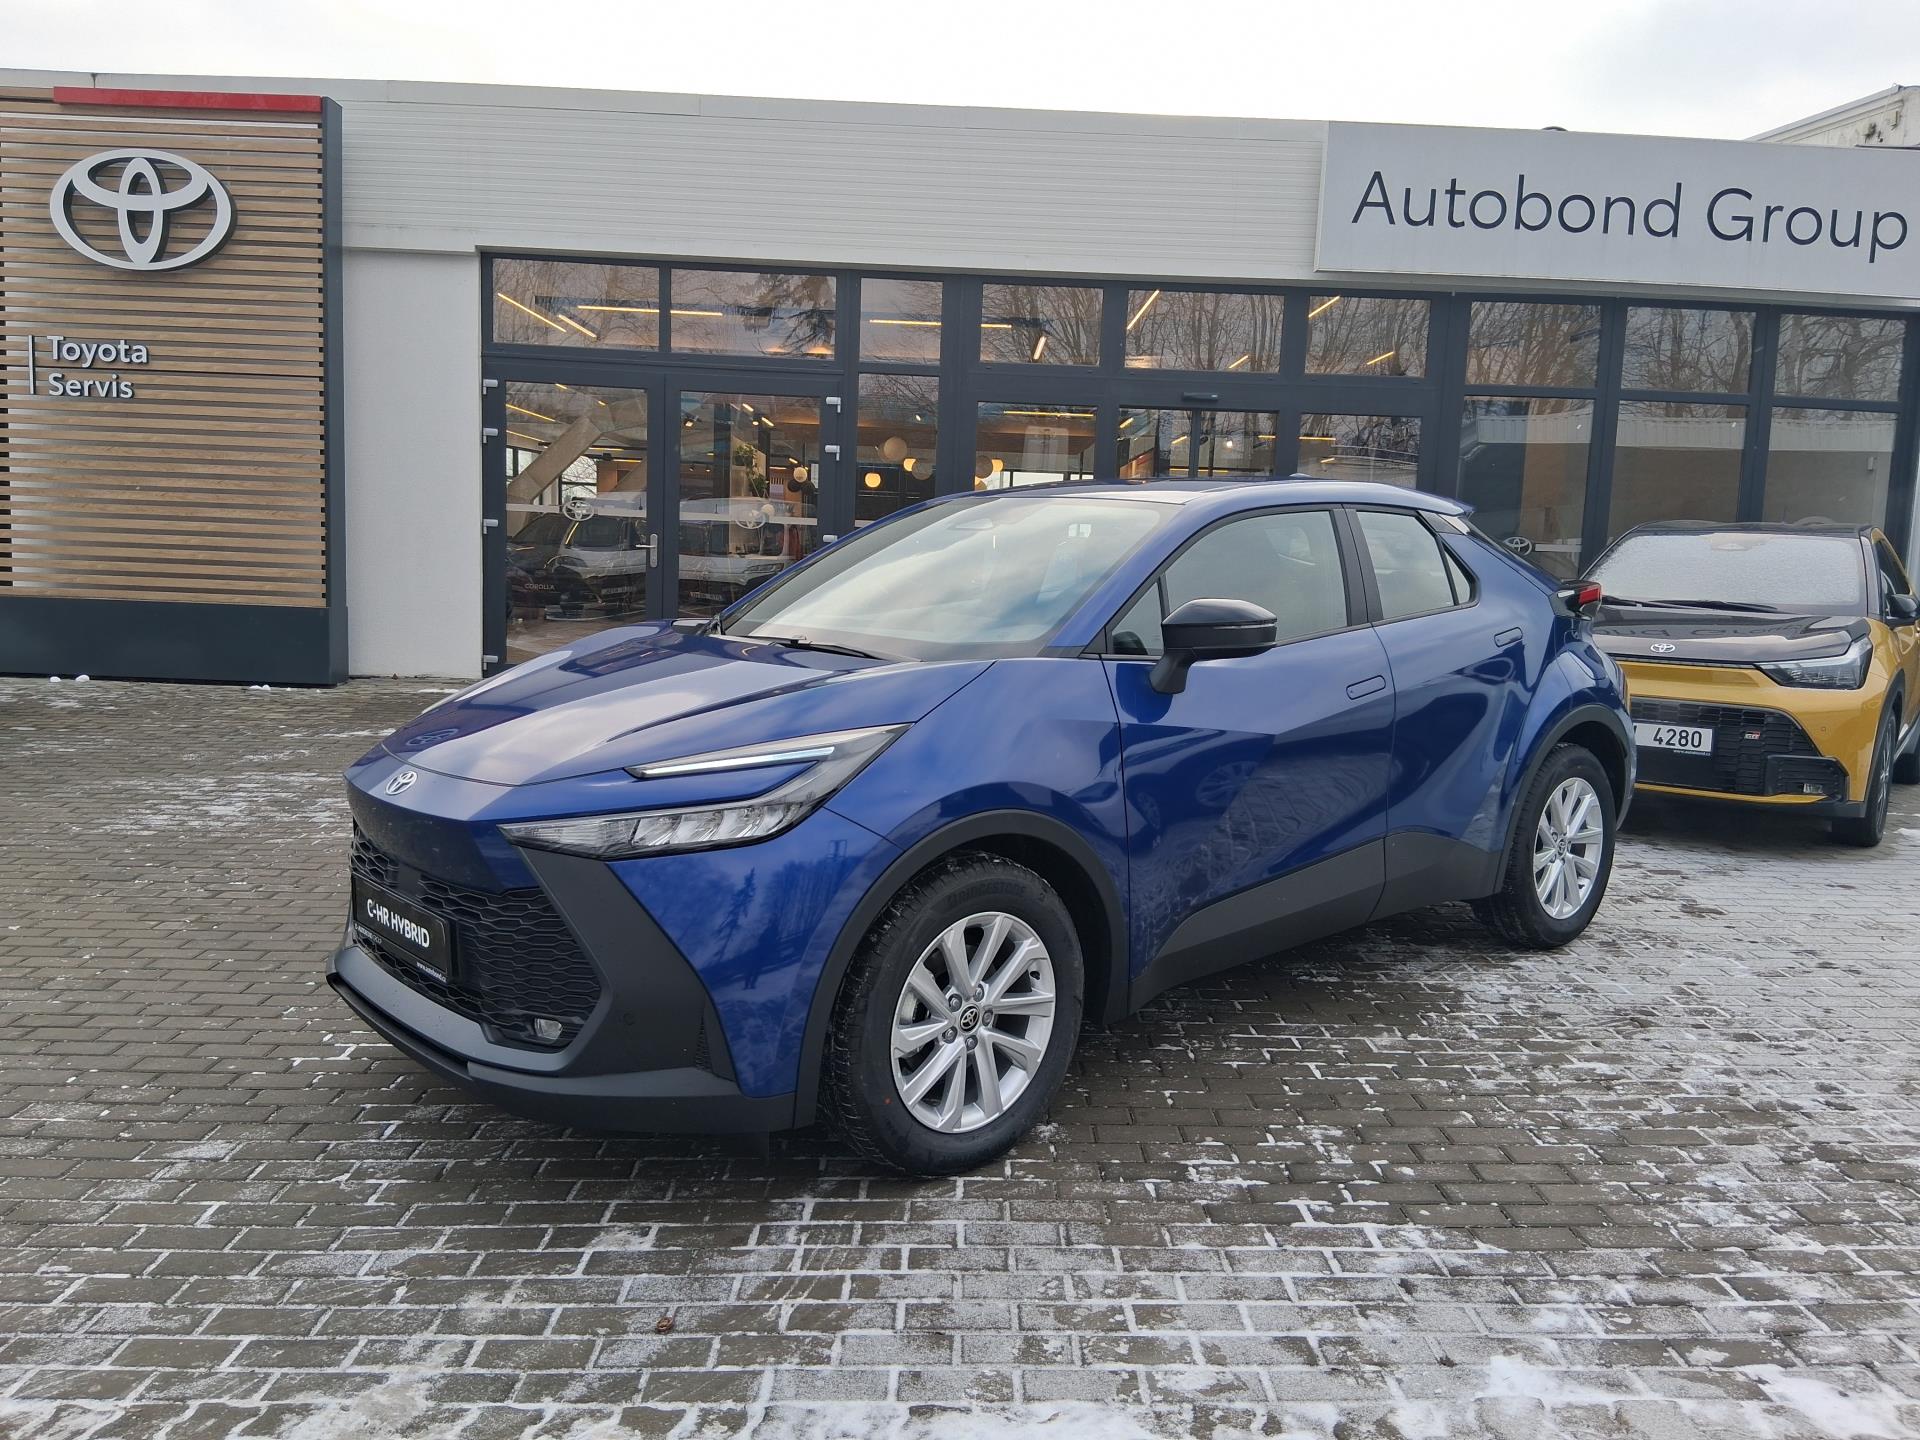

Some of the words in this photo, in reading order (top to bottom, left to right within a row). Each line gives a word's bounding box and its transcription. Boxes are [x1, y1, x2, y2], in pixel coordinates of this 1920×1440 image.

[1351, 170, 1684, 238] Autobond
[1706, 187, 1908, 264] Group
[46, 334, 149, 367] Toyota
[47, 371, 135, 398] Servis
[1652, 727, 1702, 748] 4280
[367, 898, 390, 927] C-HR
[390, 911, 430, 948] HYBRID
